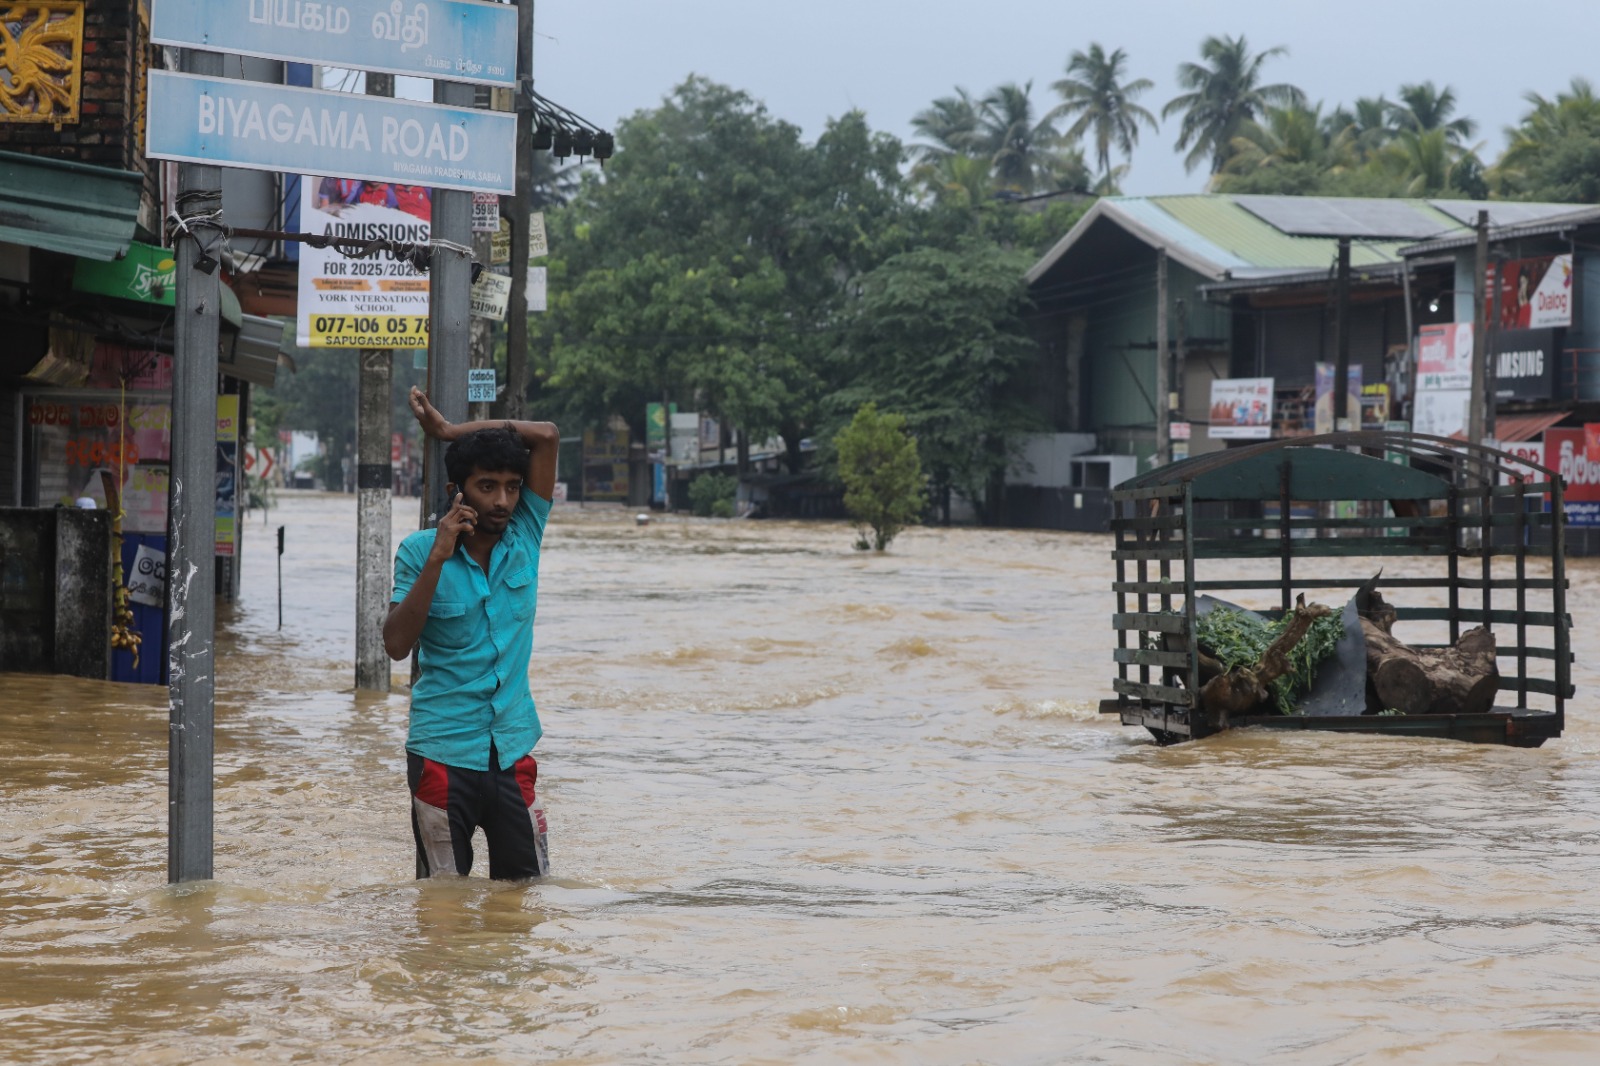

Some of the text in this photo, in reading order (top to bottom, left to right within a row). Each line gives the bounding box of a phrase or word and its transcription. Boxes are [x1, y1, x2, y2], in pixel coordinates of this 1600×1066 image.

[199, 94, 470, 162] BIYAGAMA ROAD
[393, 161, 502, 183] BIYAGAMA PRADESHIYA SABHA
[323, 222, 429, 242] ADMISSIONS
[324, 262, 421, 276] FOR 2025/202
[135, 269, 175, 292] Sprit
[319, 294, 347, 302] YORK
[1538, 292, 1567, 313] Dialog
[354, 304, 396, 312] SCHOOL
[316, 317, 379, 332] 077-106
[387, 318, 407, 333] 05
[325, 336, 425, 346] SAPUGASKANDA
